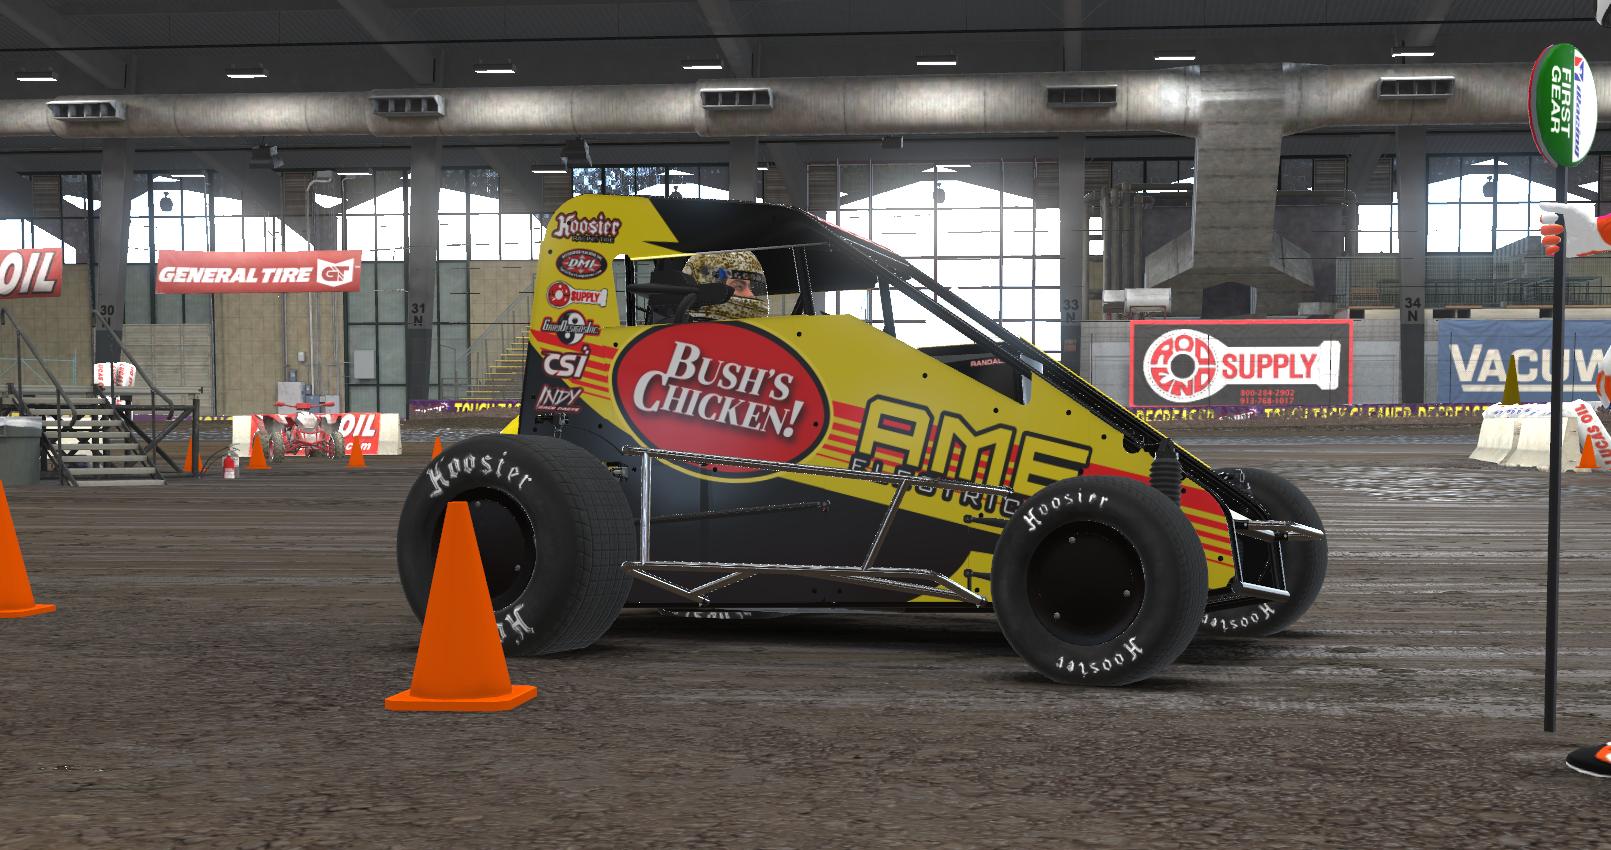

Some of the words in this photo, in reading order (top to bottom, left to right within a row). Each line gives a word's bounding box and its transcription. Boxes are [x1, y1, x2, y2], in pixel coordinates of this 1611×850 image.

[1550, 65, 1562, 133] GEAR
[1561, 67, 1572, 138] FIRST
[552, 211, 621, 238] Hoosier
[0, 251, 57, 295] OIL
[568, 257, 596, 268] DMI
[158, 266, 258, 284] GENERAL
[262, 266, 313, 284] TIRE
[411, 303, 425, 313] 31
[571, 290, 601, 303] SUPPLY
[1063, 300, 1079, 310] 33
[1404, 297, 1421, 308] 34
[100, 305, 115, 316] 30
[1065, 312, 1076, 322] N
[1408, 310, 1418, 321] N
[666, 341, 794, 401] BUSH'S
[1222, 353, 1317, 379] SUPPLY
[537, 386, 583, 406] INDY
[633, 370, 805, 438] CHICKEN!
[1575, 404, 1593, 423] OIL
[338, 414, 375, 437] OIL
[345, 441, 371, 451] cm
[855, 394, 1093, 500] AME
[427, 451, 532, 498] Hoosier
[1023, 488, 1108, 531] Hoosier
[1202, 603, 1275, 632] Hoosier
[1055, 636, 1143, 678] Hoosier
